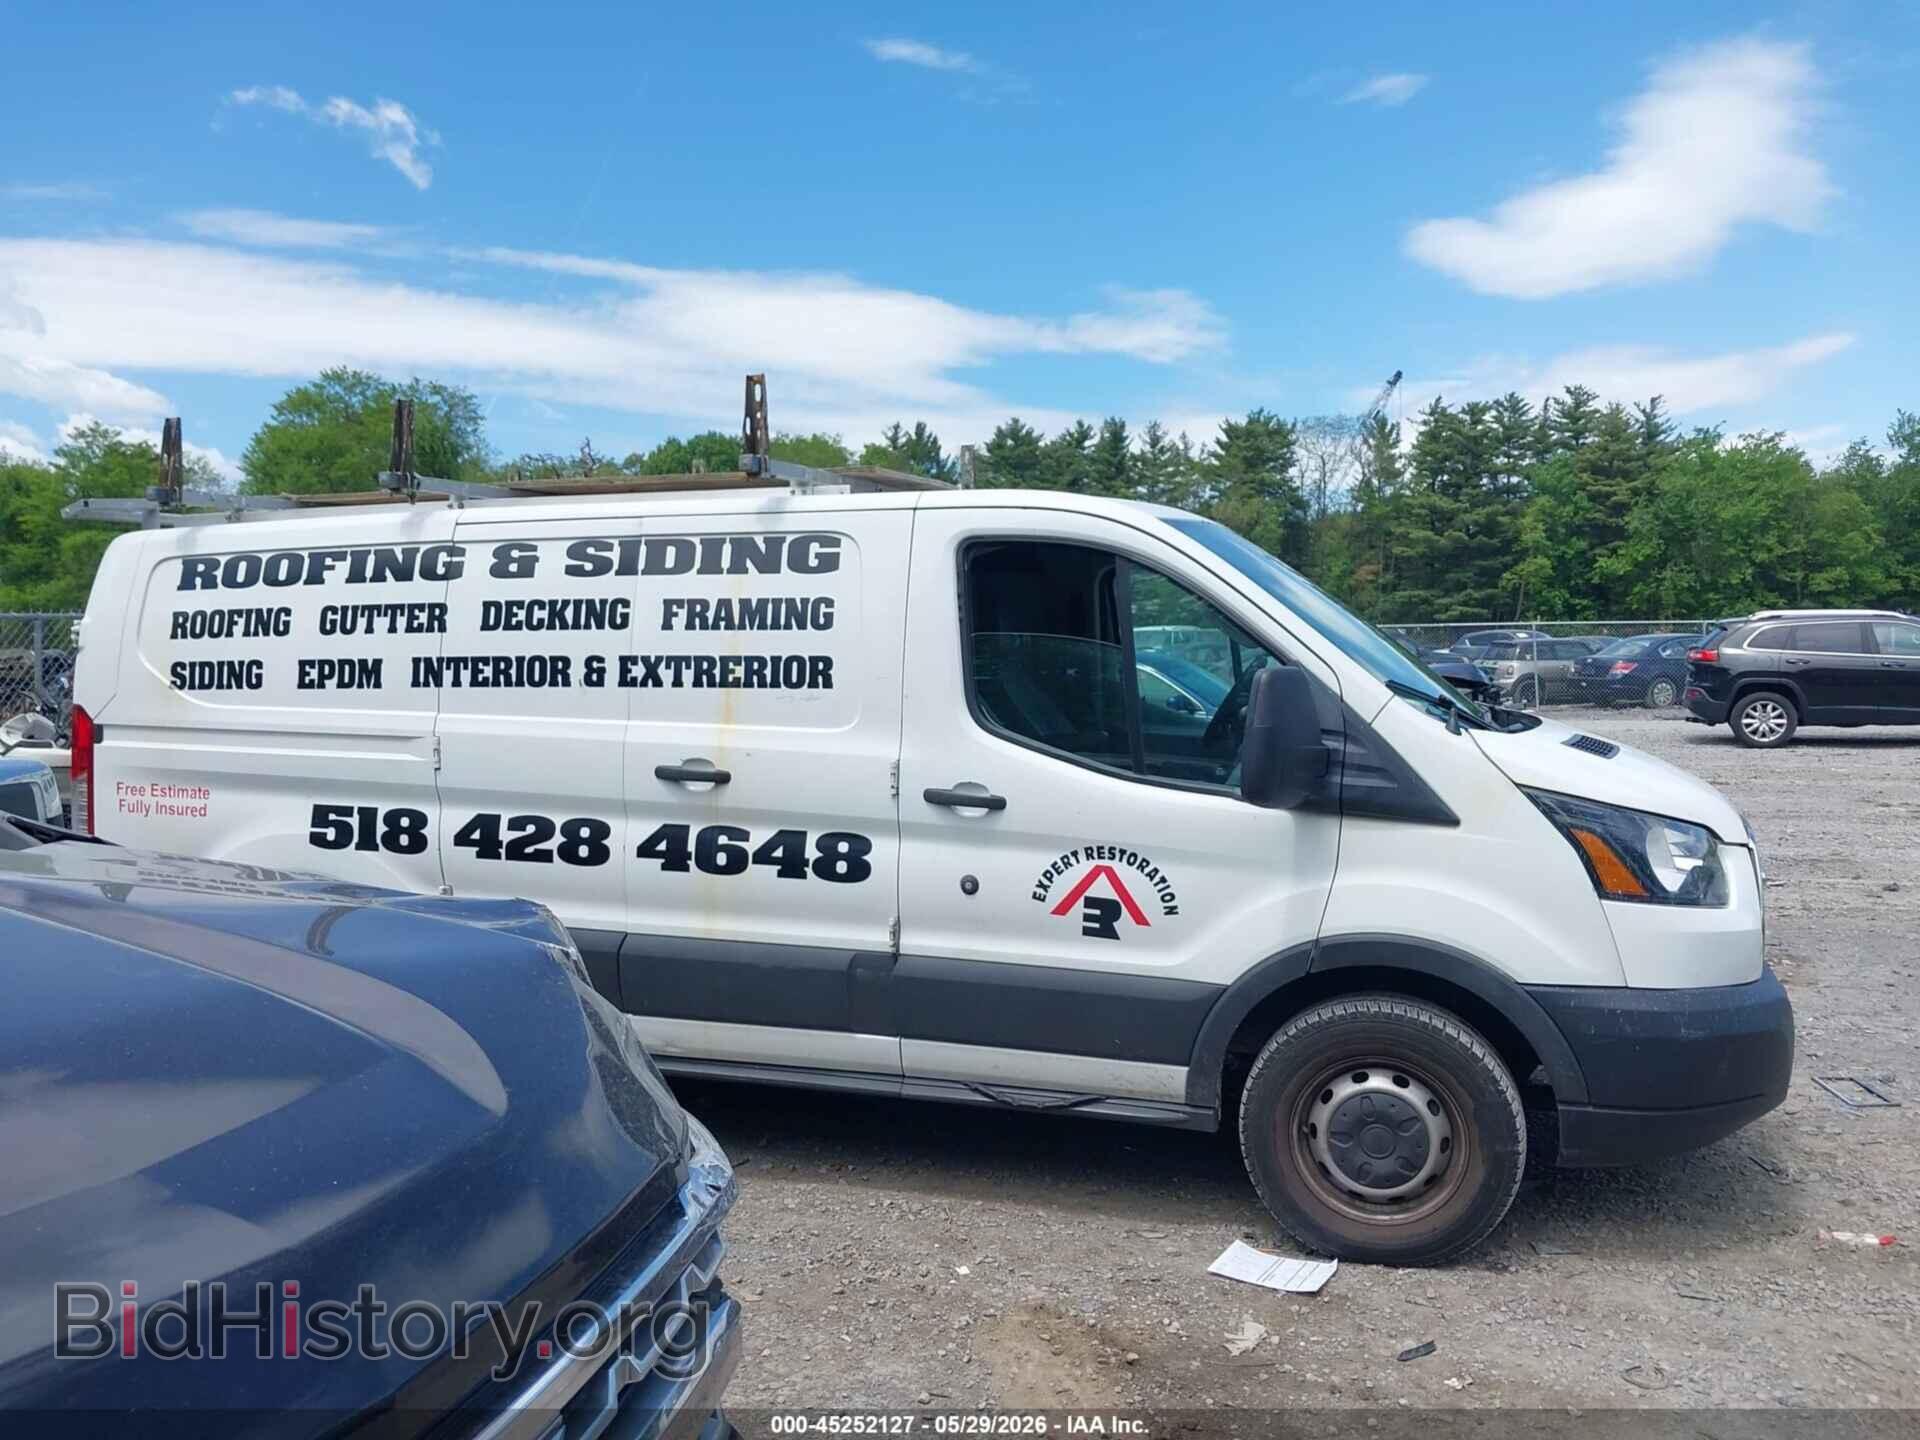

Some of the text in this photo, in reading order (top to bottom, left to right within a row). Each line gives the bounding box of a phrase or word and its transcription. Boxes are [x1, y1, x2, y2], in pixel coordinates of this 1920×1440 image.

[176, 530, 841, 591] ROOFING & SIDING
[169, 597, 835, 640] ROOFING GUTTER DECKING FRAMING
[170, 654, 834, 691] SIDING EPDM INTERIOR & EXTRERIOR
[116, 781, 210, 799] Free Estimate
[118, 798, 208, 817] Fully Insured
[309, 803, 873, 884] 518 428 4648
[1032, 845, 1179, 916] EXPERT RESTORATION
